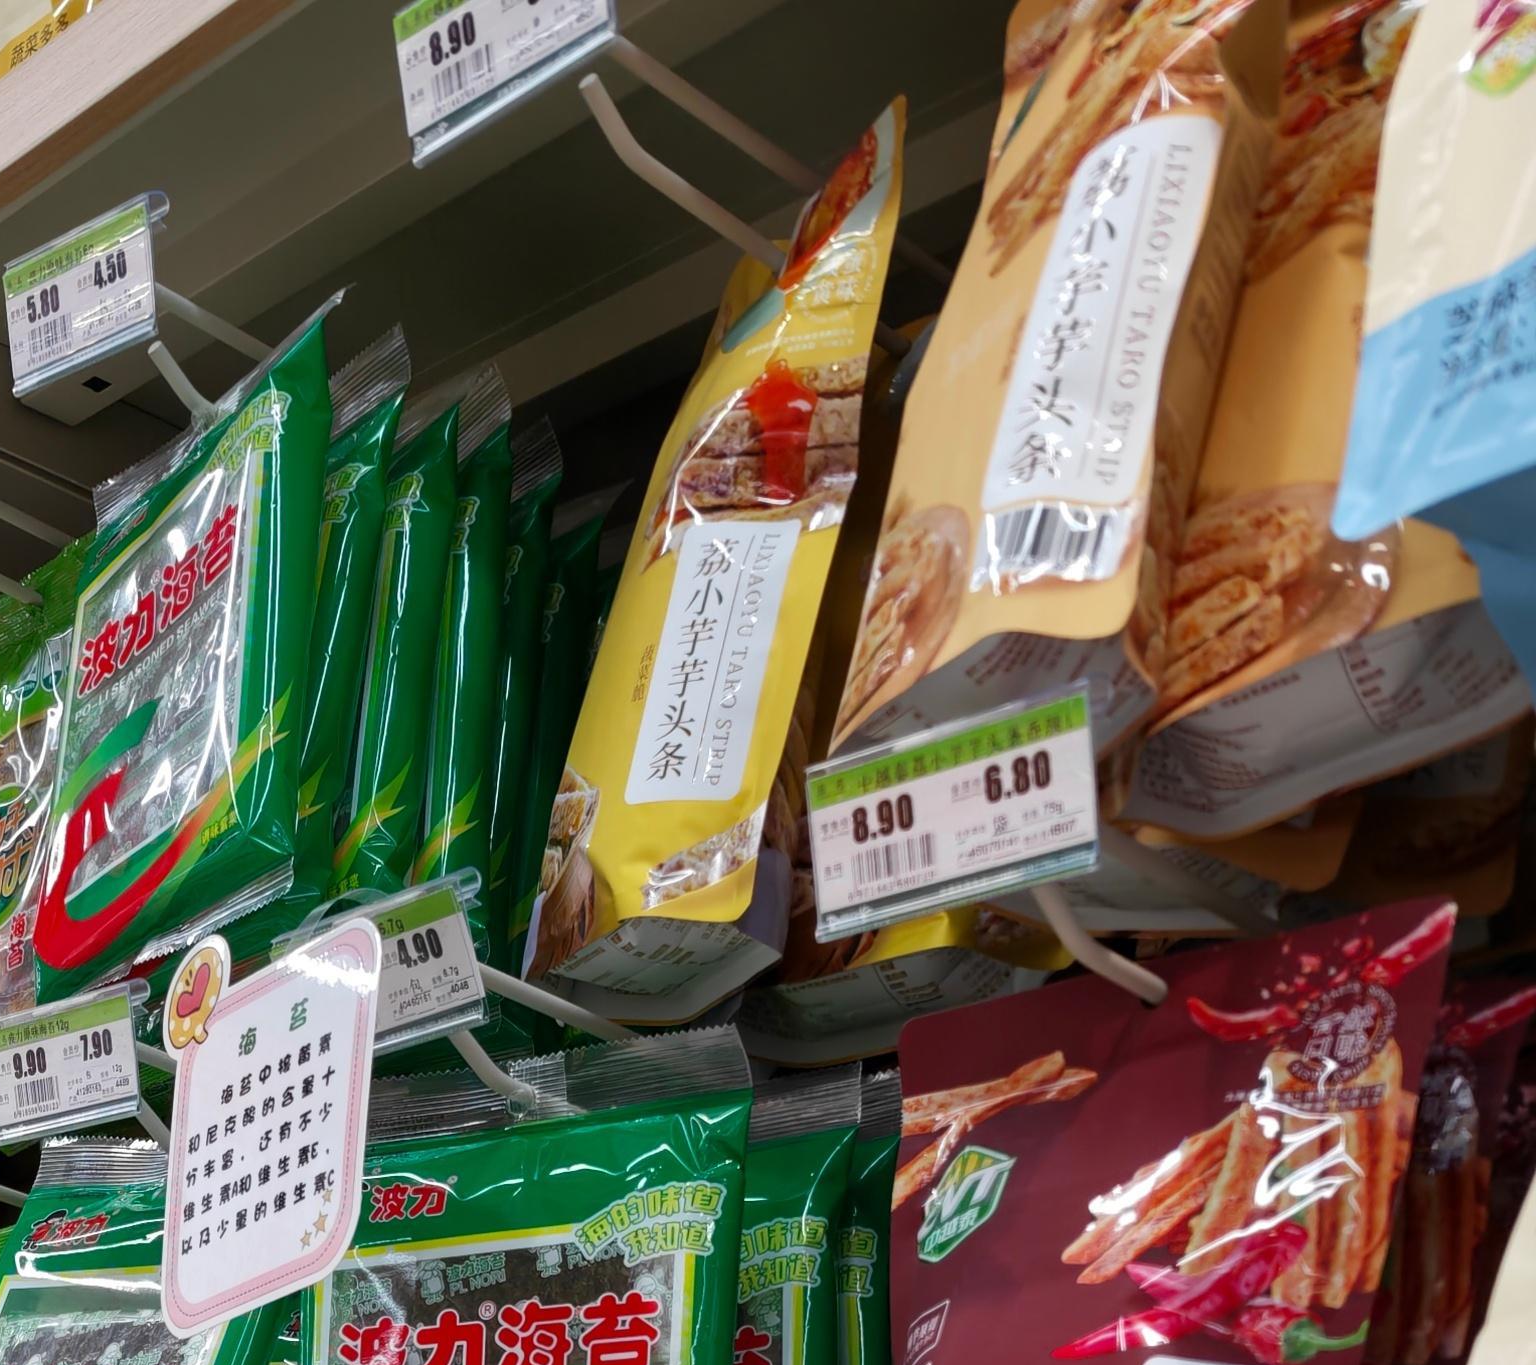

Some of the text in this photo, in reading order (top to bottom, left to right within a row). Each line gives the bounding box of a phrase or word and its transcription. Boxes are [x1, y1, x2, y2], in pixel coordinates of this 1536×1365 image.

[8, 14, 70, 70] 蔬菜多多
[429, 11, 476, 66] 8.90
[26, 250, 128, 324] 5.80 4.50
[1119, 308, 1157, 390] TARO
[76, 503, 242, 698] 波力海苔
[648, 536, 737, 784] 荔小芋芋头条
[706, 531, 782, 788] LIXIAOYU TARO STRIP
[852, 750, 1052, 844] 8.90 6.80
[5, 912, 28, 972] 海苔
[397, 927, 444, 968] 4.90
[80, 1029, 113, 1062] 7.90
[238, 997, 310, 1057] 海苔
[13, 1047, 47, 1080] 9.90
[187, 1065, 336, 1155] 和尼克酸的含量十
[51, 1210, 110, 1248] 波力
[181, 1168, 335, 1255] 以及少量的维生素C
[370, 1182, 448, 1223] 波力
[573, 1181, 727, 1258] 海的味道
[625, 1221, 714, 1264] 我知道
